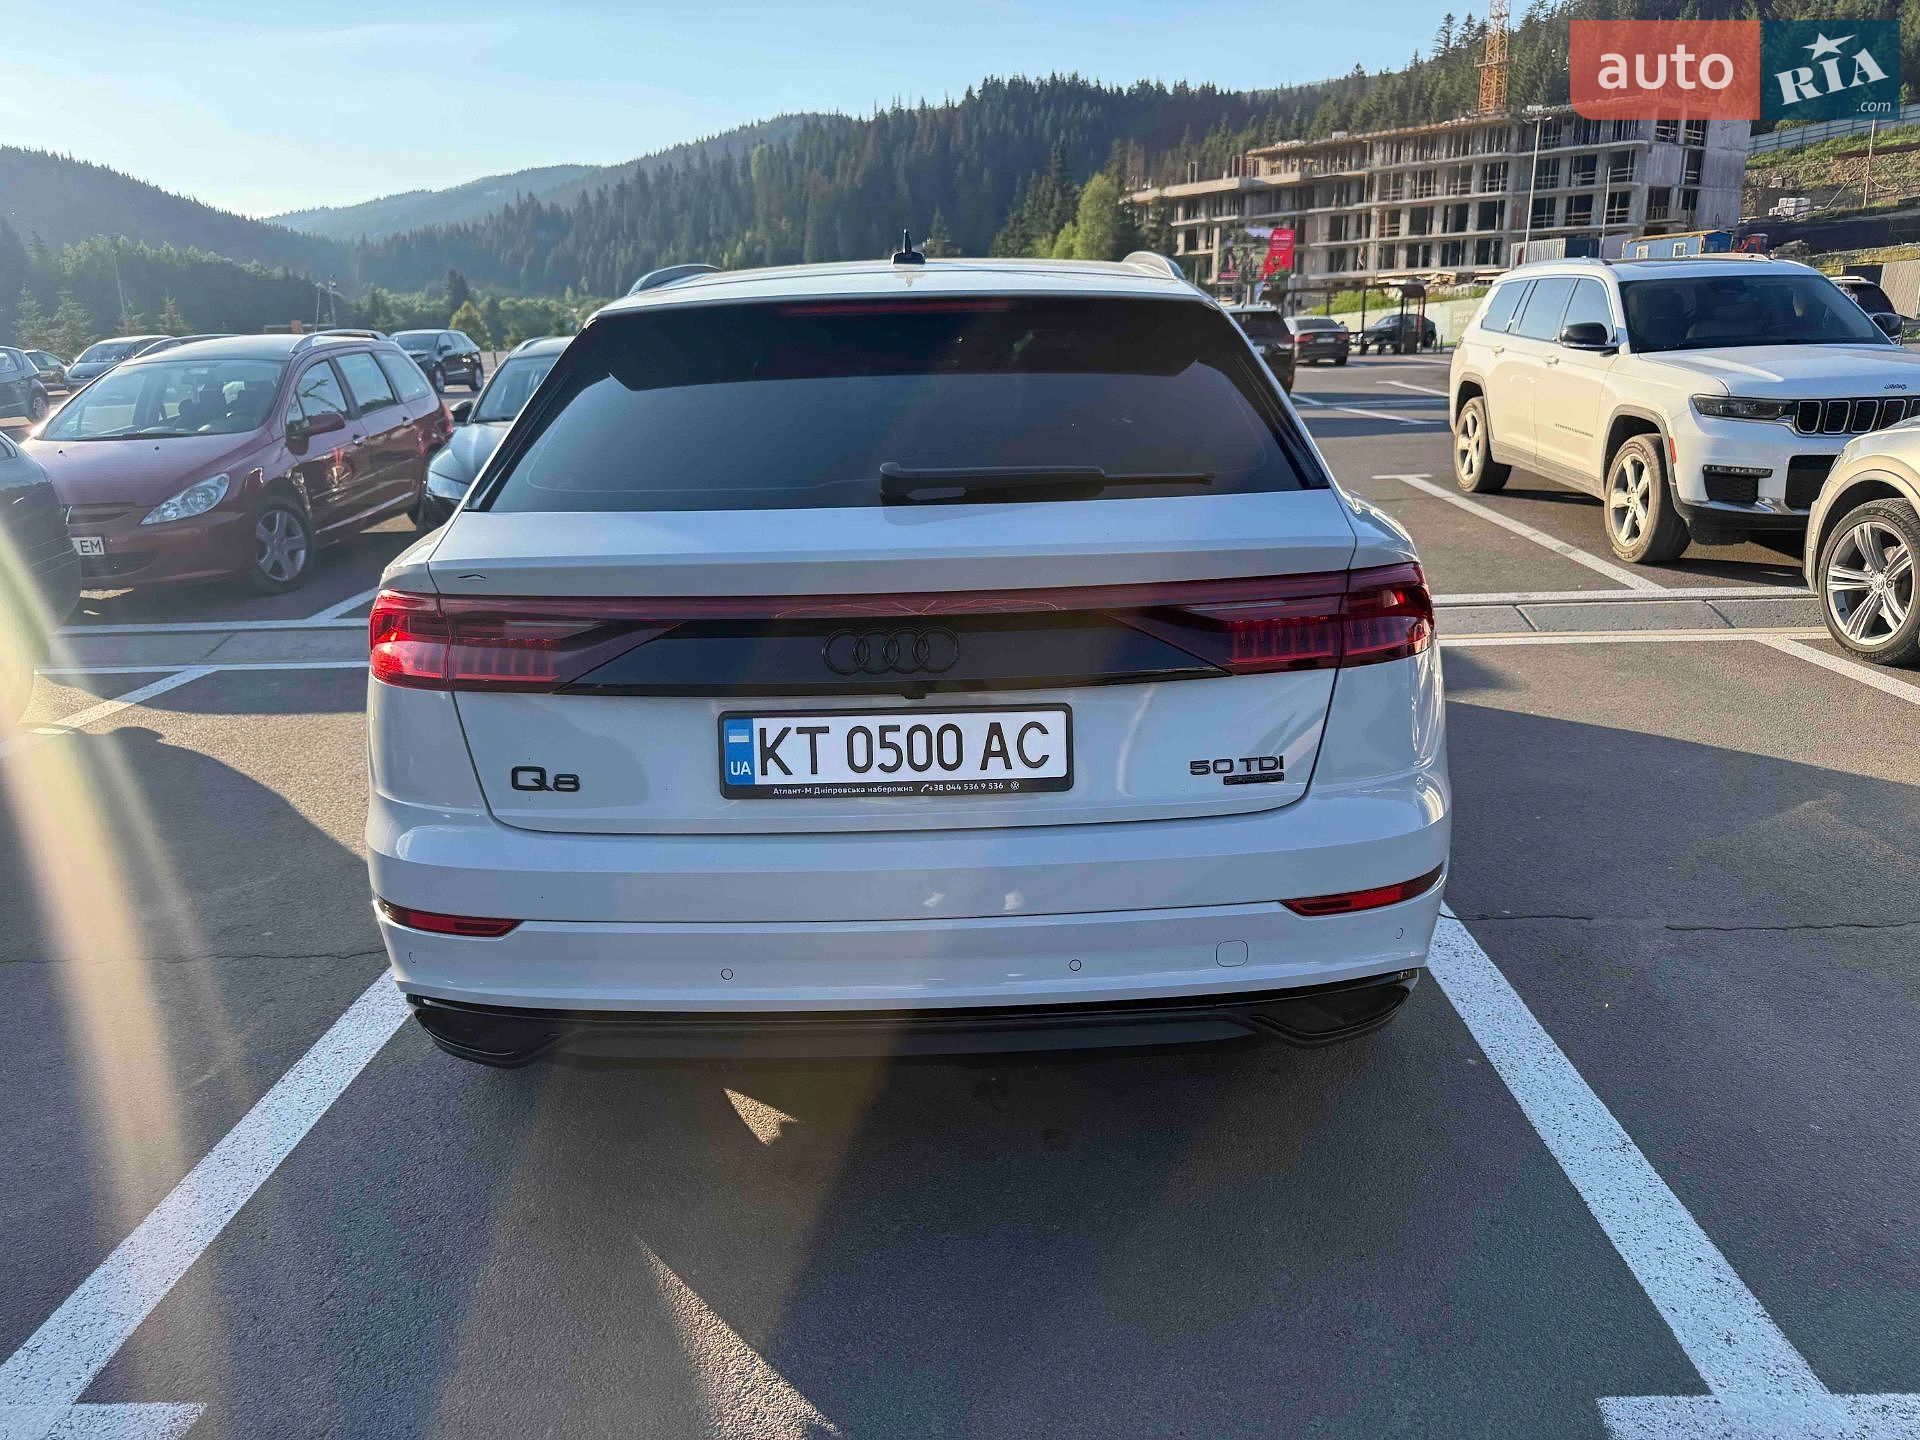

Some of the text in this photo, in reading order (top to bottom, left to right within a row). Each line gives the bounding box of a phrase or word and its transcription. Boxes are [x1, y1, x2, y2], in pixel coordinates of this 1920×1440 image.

[80, 540, 102, 553] EM
[759, 721, 1050, 776] KT 0500 AC
[730, 761, 751, 776] UA
[1190, 755, 1284, 775] 50 TDI
[511, 765, 580, 792] Q8
[988, 782, 1004, 790] 536
[773, 785, 914, 796] Атлант-М Дніпровська набережна
